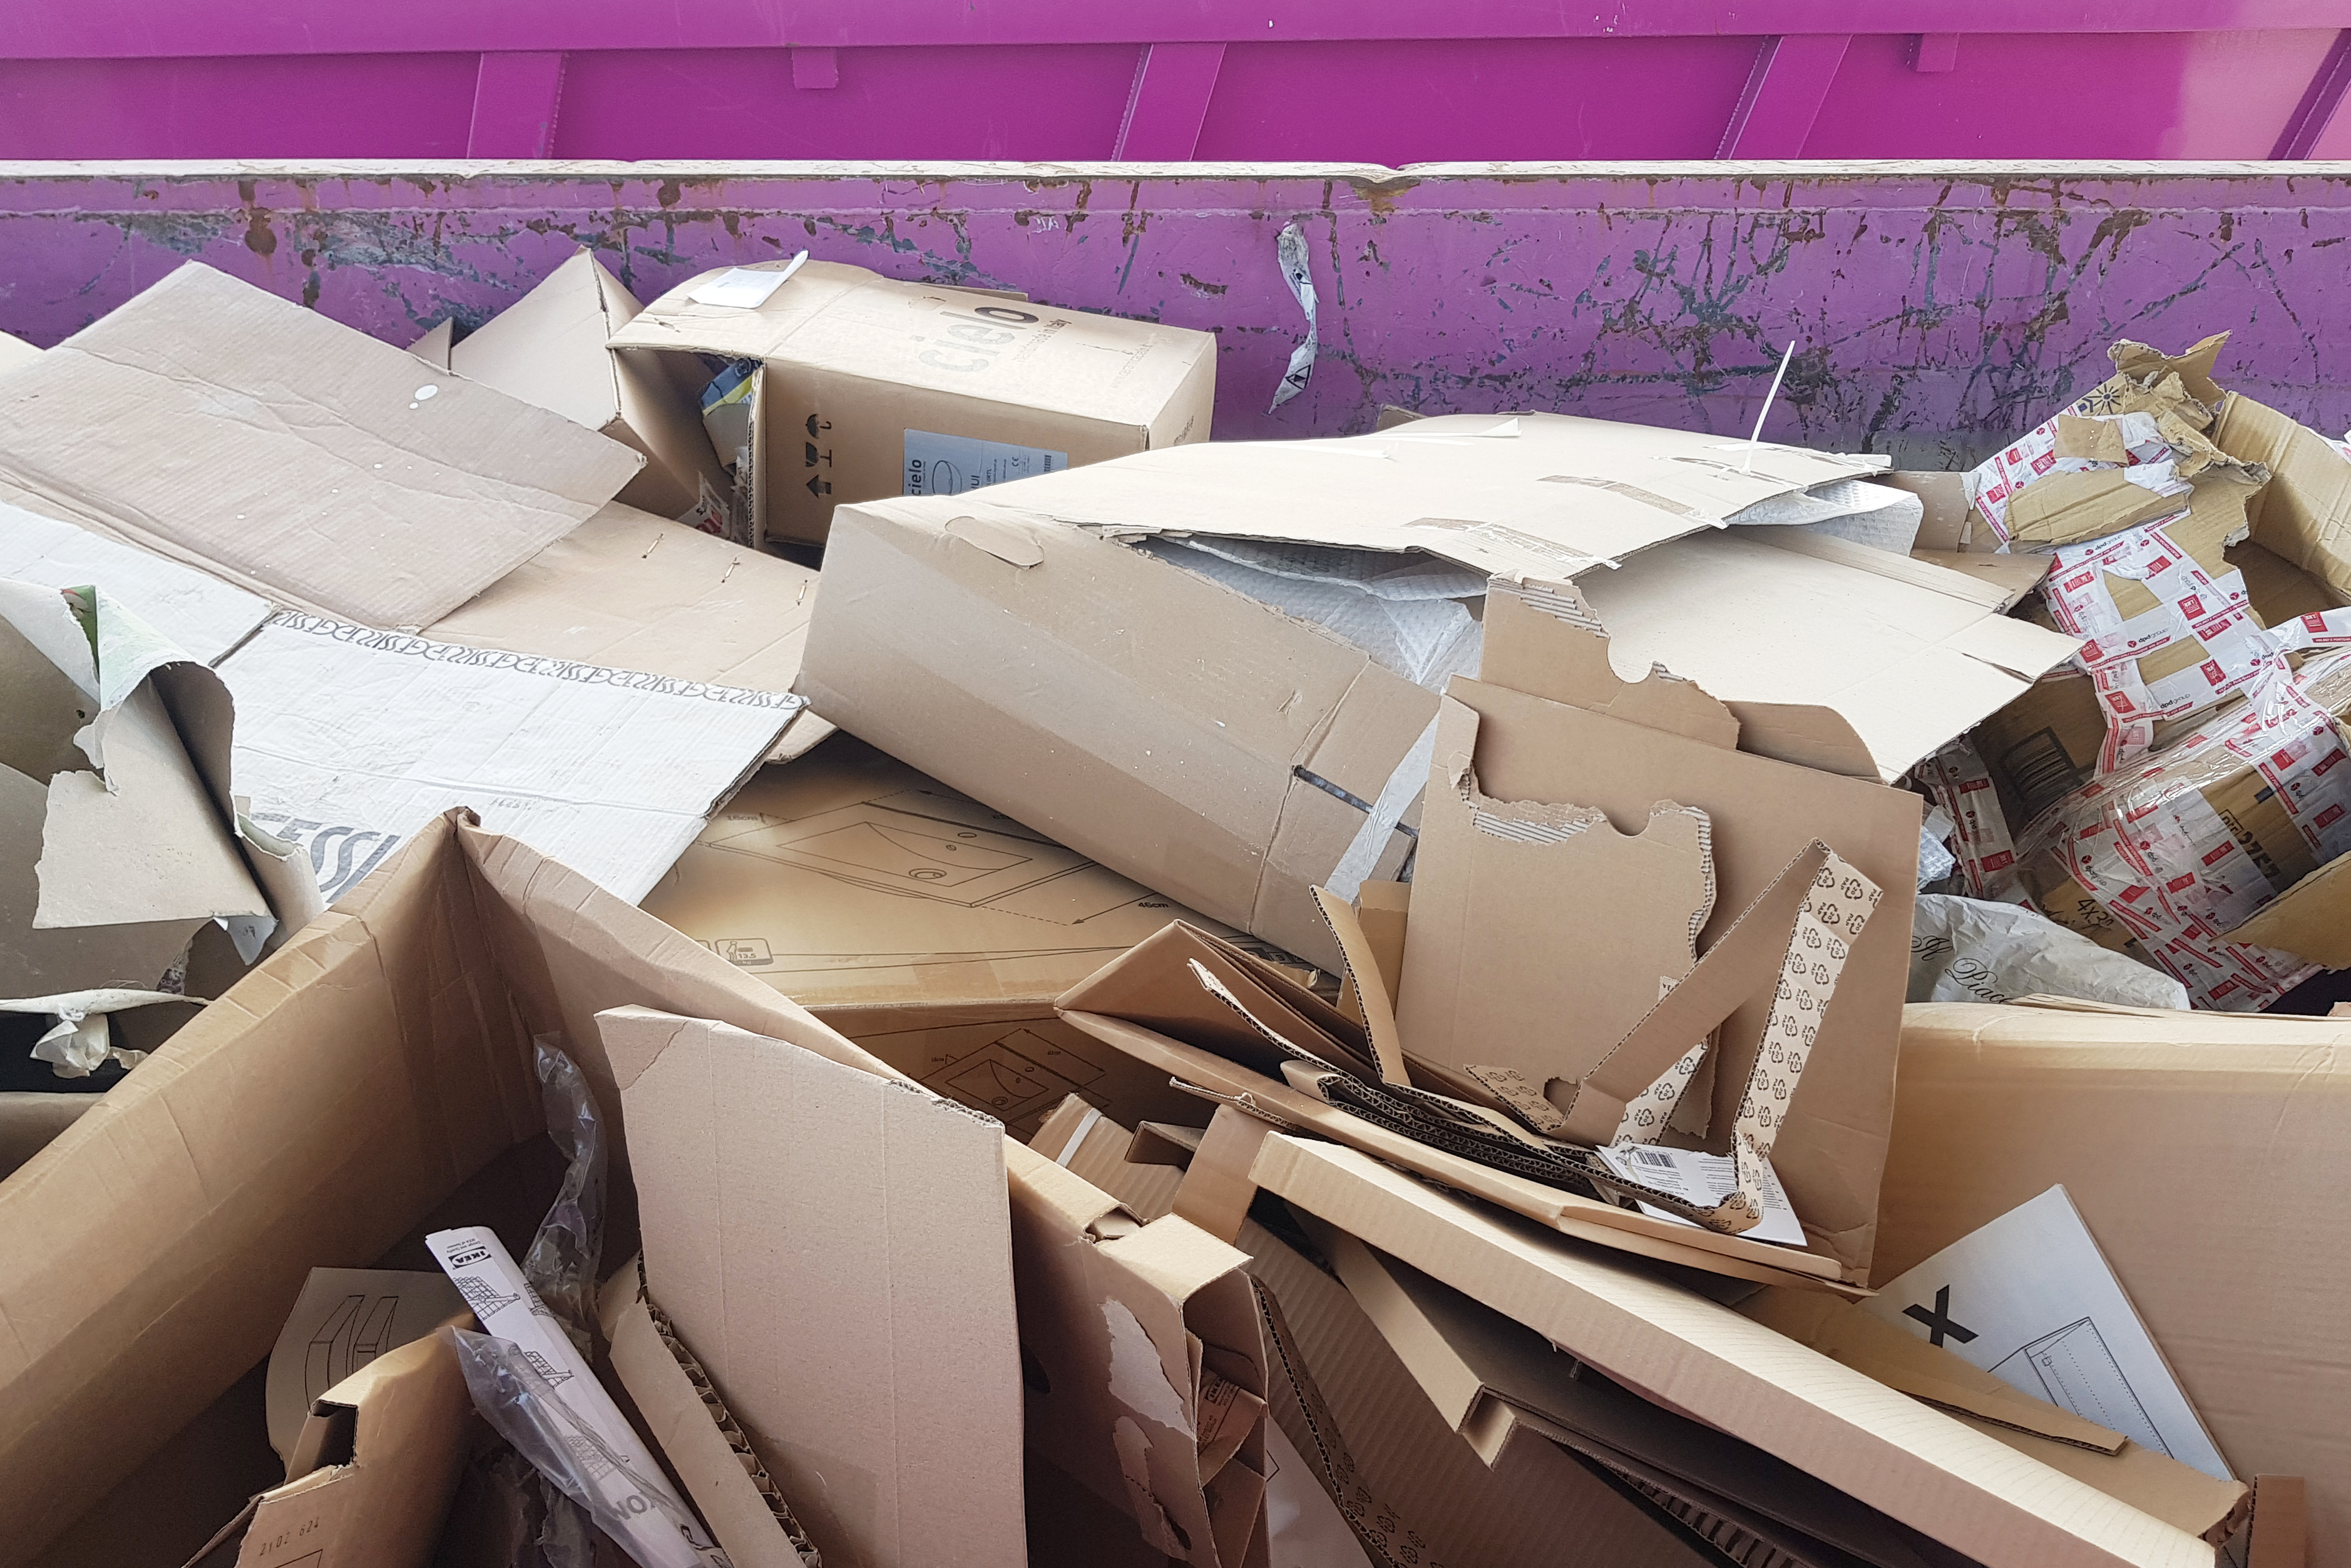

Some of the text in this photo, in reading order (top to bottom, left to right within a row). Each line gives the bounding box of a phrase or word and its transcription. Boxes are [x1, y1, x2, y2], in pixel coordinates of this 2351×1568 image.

[909, 307, 1039, 372] cielo
[2138, 628, 2168, 643] dpdgroup
[2160, 693, 2190, 709] dpdgroup
[1841, 878, 1849, 889] PAP
[1818, 902, 1826, 915] PAP
[455, 1251, 486, 1263] IKEA
